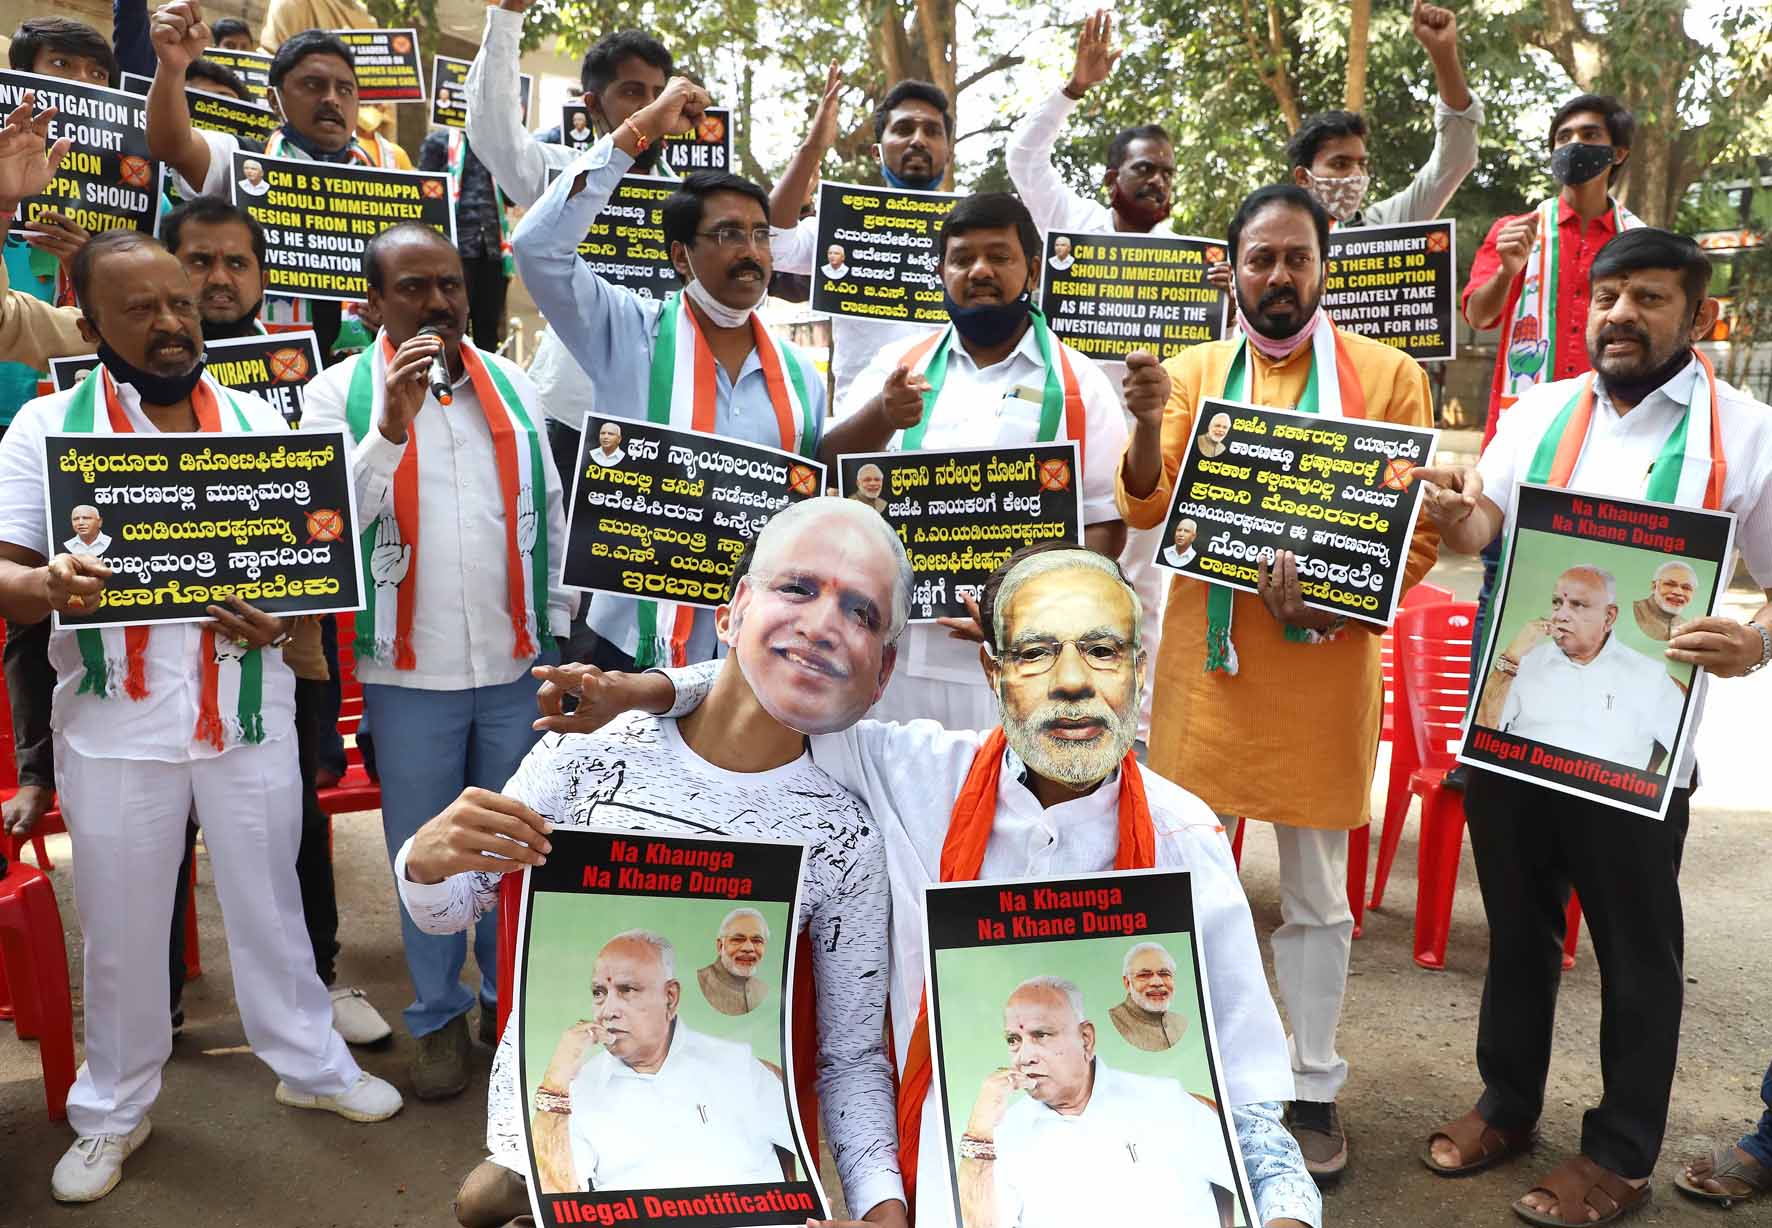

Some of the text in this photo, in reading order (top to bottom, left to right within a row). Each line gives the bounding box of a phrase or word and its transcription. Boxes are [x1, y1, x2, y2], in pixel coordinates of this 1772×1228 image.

[65, 122, 124, 152] COURT
[672, 144, 724, 168] AS HE IS
[86, 182, 149, 213] SHOULD
[268, 171, 420, 200] CM B S YEDIYURAPPA
[267, 190, 424, 219] SHOULD IMMEDIATELY
[305, 215, 348, 232] FROM
[352, 219, 376, 235] HIS
[284, 231, 304, 248] HE
[308, 234, 365, 253] SHOULD
[1074, 245, 1203, 264] CM B S YEDIYURAPPA
[1346, 237, 1427, 256] GOVERNMENT
[1071, 264, 1203, 283] SHOULD IMMEDIATELY
[1342, 257, 1385, 272] THERE
[1389, 255, 1402, 268] IS
[1406, 254, 1425, 267] NO
[1052, 281, 1218, 303] RESIGN FROM HIS POSITION
[1348, 270, 1436, 288] CORRUPTION
[1402, 286, 1436, 300] TAKE
[1060, 300, 1207, 321] AS HE SHOULD FACE THE
[1393, 302, 1433, 317] FROM
[1052, 317, 1212, 341] INVESTIGATION ON ILLEGAL
[1384, 320, 1411, 333] FOR
[1415, 318, 1439, 331] HIS
[1233, 416, 1421, 459] ಬಿಜೆಪಿ ಸರ್ಕಾರದಲ್ಲಿ ಯಾವುದೇ
[60, 444, 335, 483] ಬೆಳ್ಳಂದೂರು ಡಿನೋಟಿಫಿಕೇಷನ್
[627, 437, 788, 485] ಘನ ನ್ಯಾಯಾಲಯದ
[1229, 441, 1295, 472] ಕಾರಣಕ್ಕೂ
[586, 463, 653, 495] ನಿಗಾದಲ್ಲಿ
[661, 477, 705, 498] ತನಿಖೆ
[890, 453, 1036, 496] ಪ್ರಧಾನಿ ನರೇಂದ್ರ ಮೋದಿಗೆ
[1198, 458, 1251, 480] ಅವಕಾಶ
[1341, 486, 1399, 508] ಎಂಬುವ
[94, 480, 312, 511] ಹಗರಣದಲ್ಲಿ ಮುಖ್ಯಮಂತ್ರಿ
[588, 487, 704, 522] ಆದೇಶಿಸಿರುವ
[889, 491, 1042, 517] ಬಿಜೆಪಿ ನಾಯಕರಿಗೆ ಕೇಂದ್ರ
[1190, 481, 1390, 534] ಪ್ರಧಾನಿ ಮೋದಿರವರೇ
[1572, 498, 1669, 530] Na Khaunga
[122, 516, 297, 545] ಯಡಿಯೂರಪ್ಪನನ್ನು
[599, 516, 707, 553] ಮುಖ್ಯಮಂತ್ರಿ
[1552, 515, 1686, 554] Na Khane Dunga
[228, 545, 332, 579] ಸ್ಥಾನದಿಂದ
[1290, 526, 1307, 541] ಈ
[1312, 530, 1391, 568] ಹಗರಣವನ್ನು
[1474, 730, 1659, 799] Illegal Denotification
[610, 840, 735, 873] Na Khaunga
[582, 865, 753, 899] Na Khane Dunga
[999, 887, 1122, 913] Na Khaunga
[977, 910, 1147, 941] Na Khane Dunga
[552, 1190, 814, 1226] Illegal Denotification
